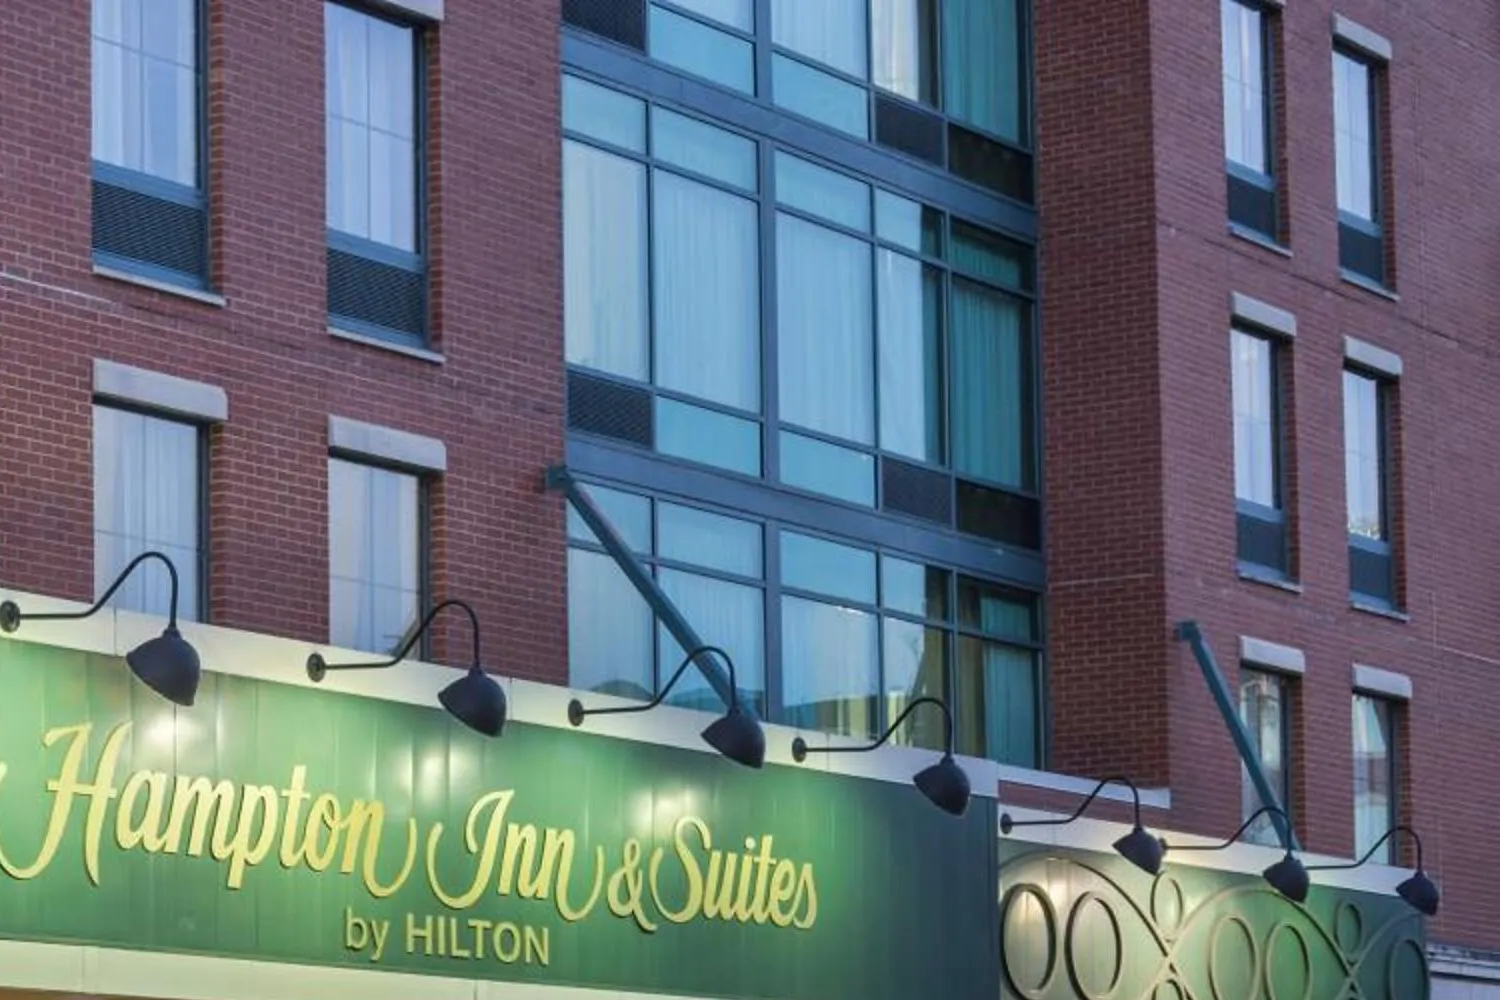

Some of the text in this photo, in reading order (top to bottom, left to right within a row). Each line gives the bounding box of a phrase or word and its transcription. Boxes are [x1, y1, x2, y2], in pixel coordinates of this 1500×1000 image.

[426, 789, 605, 922] Inn
[607, 838, 657, 933] &
[649, 815, 818, 930] Suites
[345, 906, 550, 966] by HILTON
